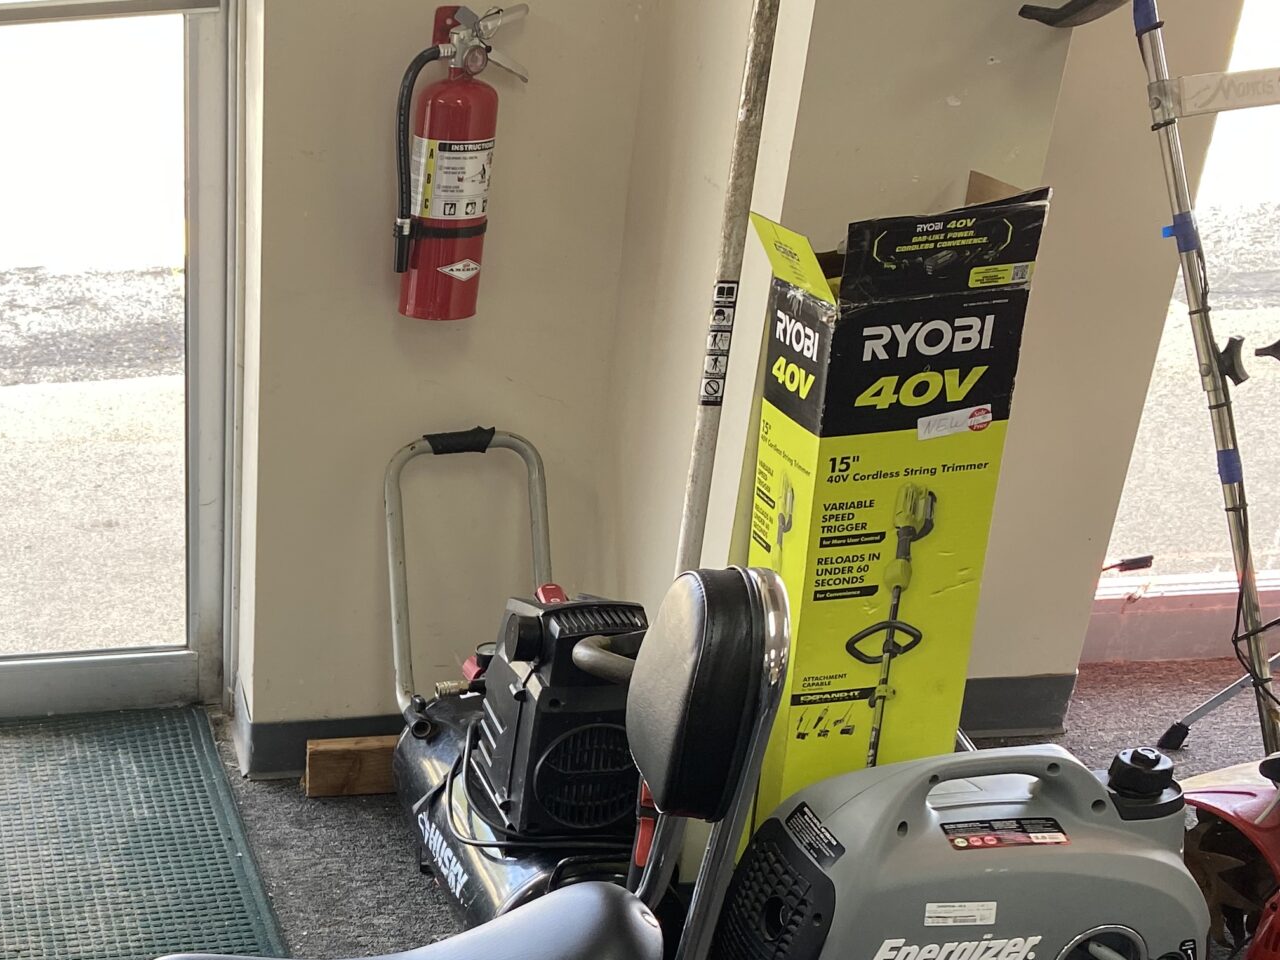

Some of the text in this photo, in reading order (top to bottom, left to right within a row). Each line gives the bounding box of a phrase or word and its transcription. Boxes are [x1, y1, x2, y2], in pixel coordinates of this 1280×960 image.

[916, 218, 977, 233] RYOBI 40V
[776, 310, 819, 362] RYOBI
[862, 315, 994, 362] RYOBI
[772, 356, 816, 400] 40V
[854, 365, 990, 410] 40V
[828, 455, 860, 474] 15"
[827, 462, 990, 484] 40V Cordless String Trimmer
[823, 499, 876, 512] VARIABLE
[821, 512, 855, 523] SPEED
[820, 522, 868, 534] TRIGGER
[816, 552, 881, 566] RELOADS IN
[815, 564, 869, 577] UNDER 60
[814, 575, 865, 588] SECONDS
[803, 673, 848, 682] ATTACHMENT
